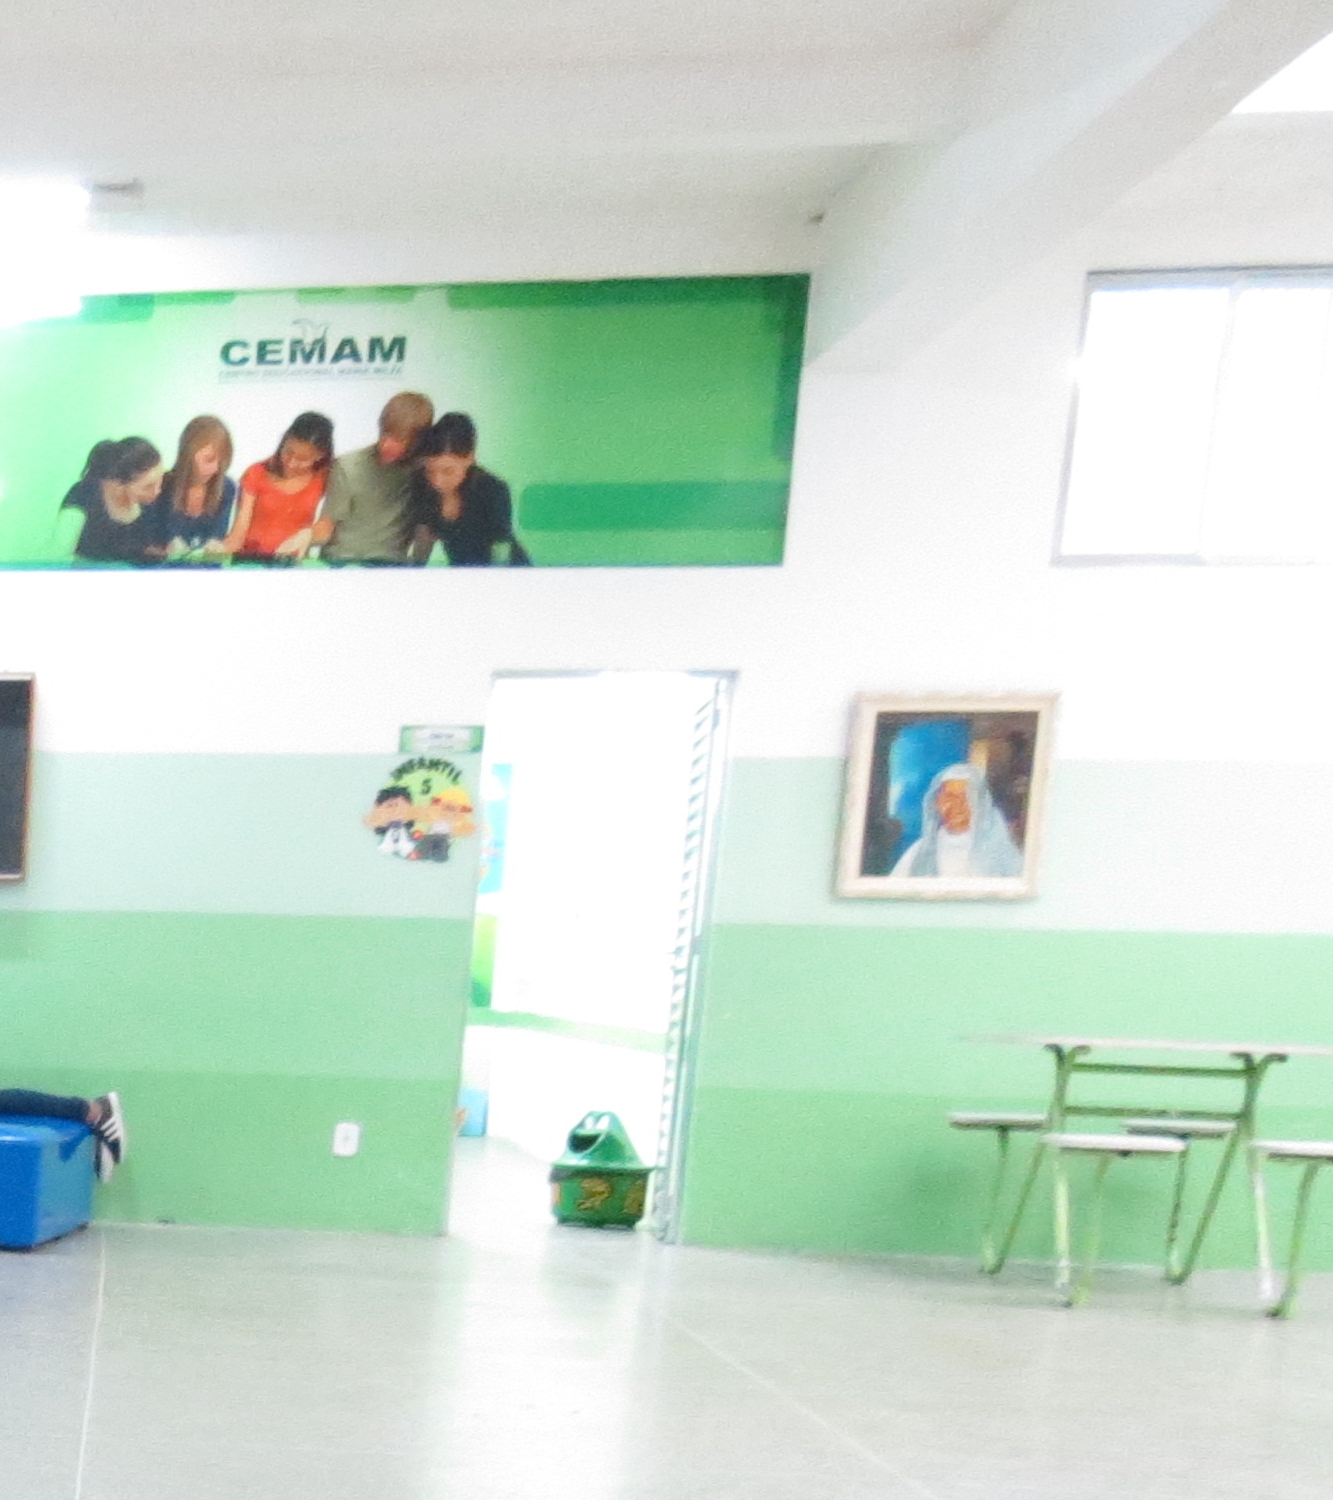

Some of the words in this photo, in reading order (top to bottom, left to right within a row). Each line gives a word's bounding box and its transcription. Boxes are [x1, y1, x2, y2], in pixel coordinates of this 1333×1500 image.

[220, 335, 407, 366] CEMAM
[390, 756, 463, 785] INFANTIL
[420, 778, 433, 795] 5
